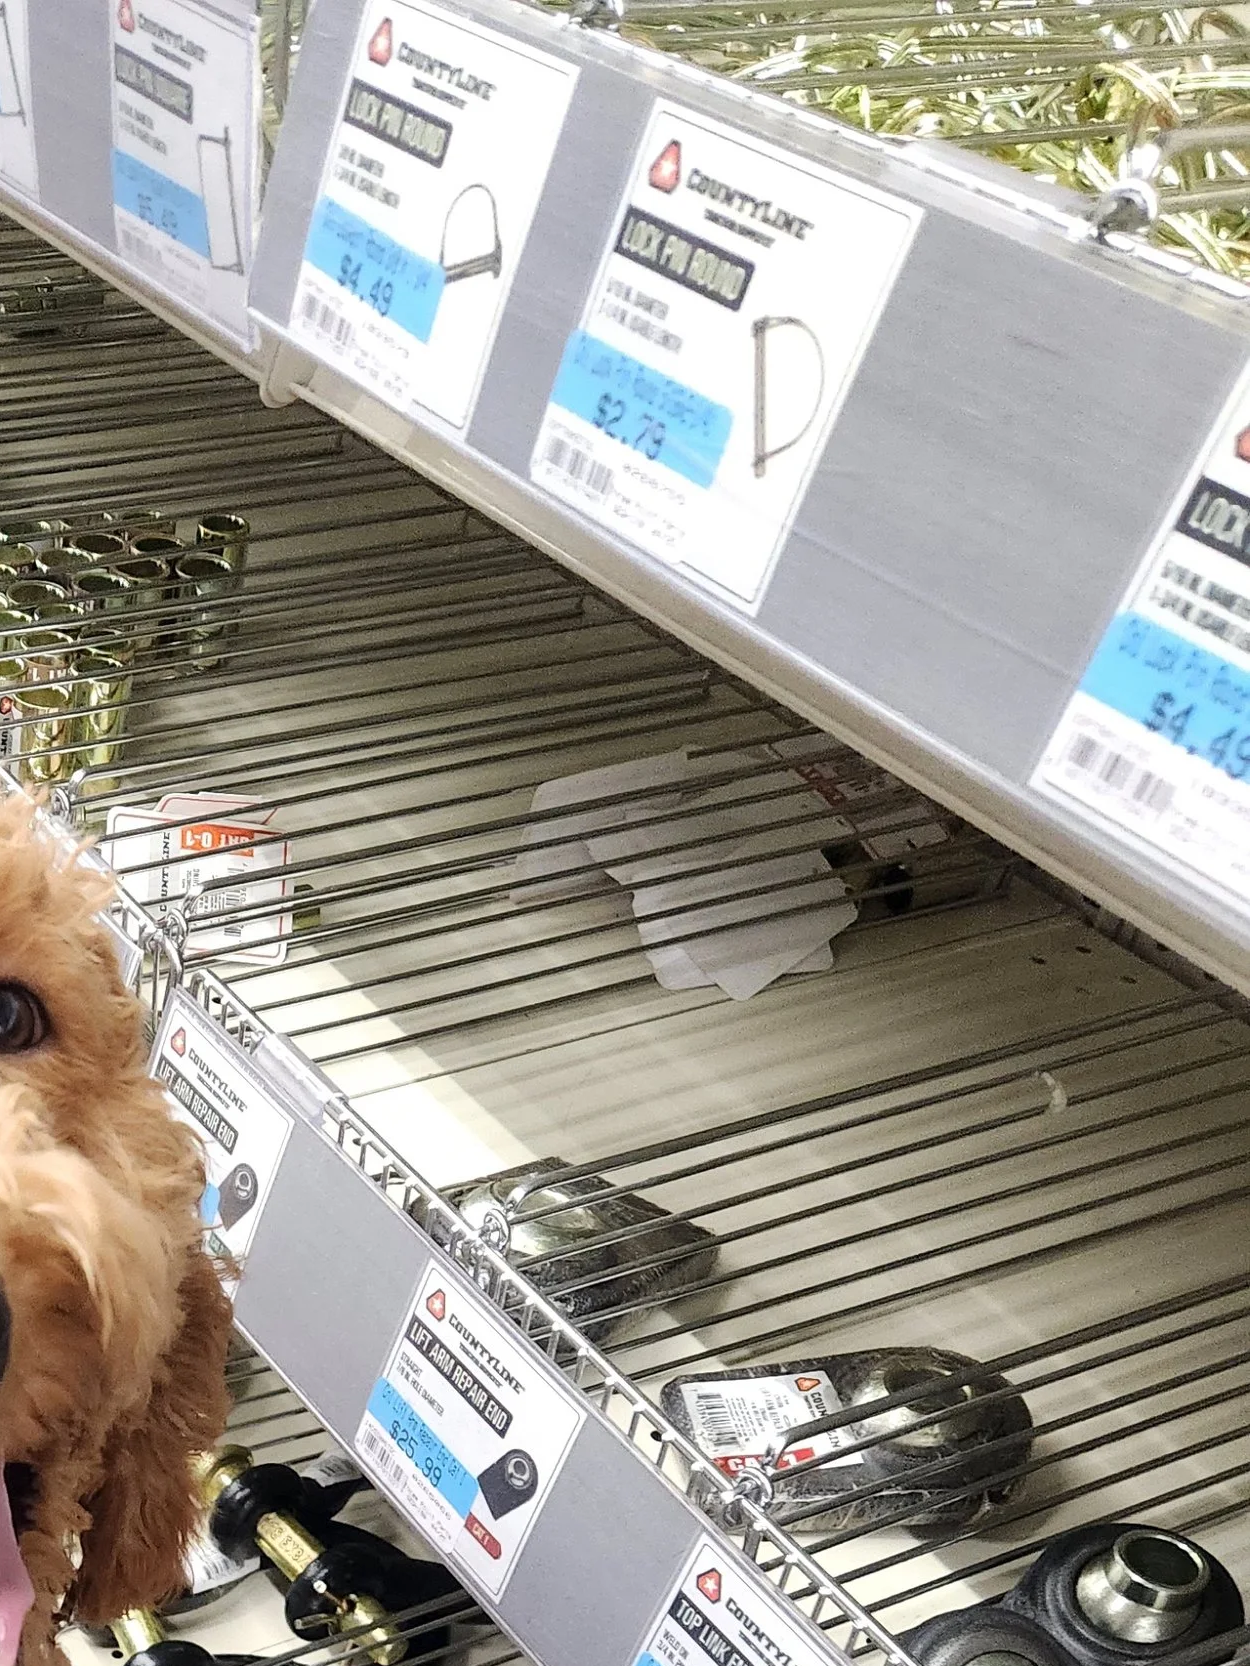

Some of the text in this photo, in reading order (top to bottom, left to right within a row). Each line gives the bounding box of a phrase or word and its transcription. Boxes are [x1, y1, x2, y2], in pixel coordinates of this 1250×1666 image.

[621, 215, 665, 261] LOCK
[334, 252, 395, 318] $4.49
[590, 388, 669, 463] $2.79
[158, 1059, 176, 1088] LIFT
[174, 1075, 194, 1106] ARM
[190, 1093, 219, 1133] REPAIR
[216, 1120, 235, 1150] END
[187, 1047, 248, 1114] COUNTYLINE
[408, 1320, 433, 1354] LIFT
[429, 1341, 455, 1377] ARM
[450, 1364, 488, 1411] REPAIR
[484, 1399, 508, 1432] END
[447, 1313, 526, 1397] COUNTYLINE
[386, 1418, 444, 1489] $25.99
[674, 1597, 704, 1635] TOP
[698, 1622, 732, 1665] LINK
